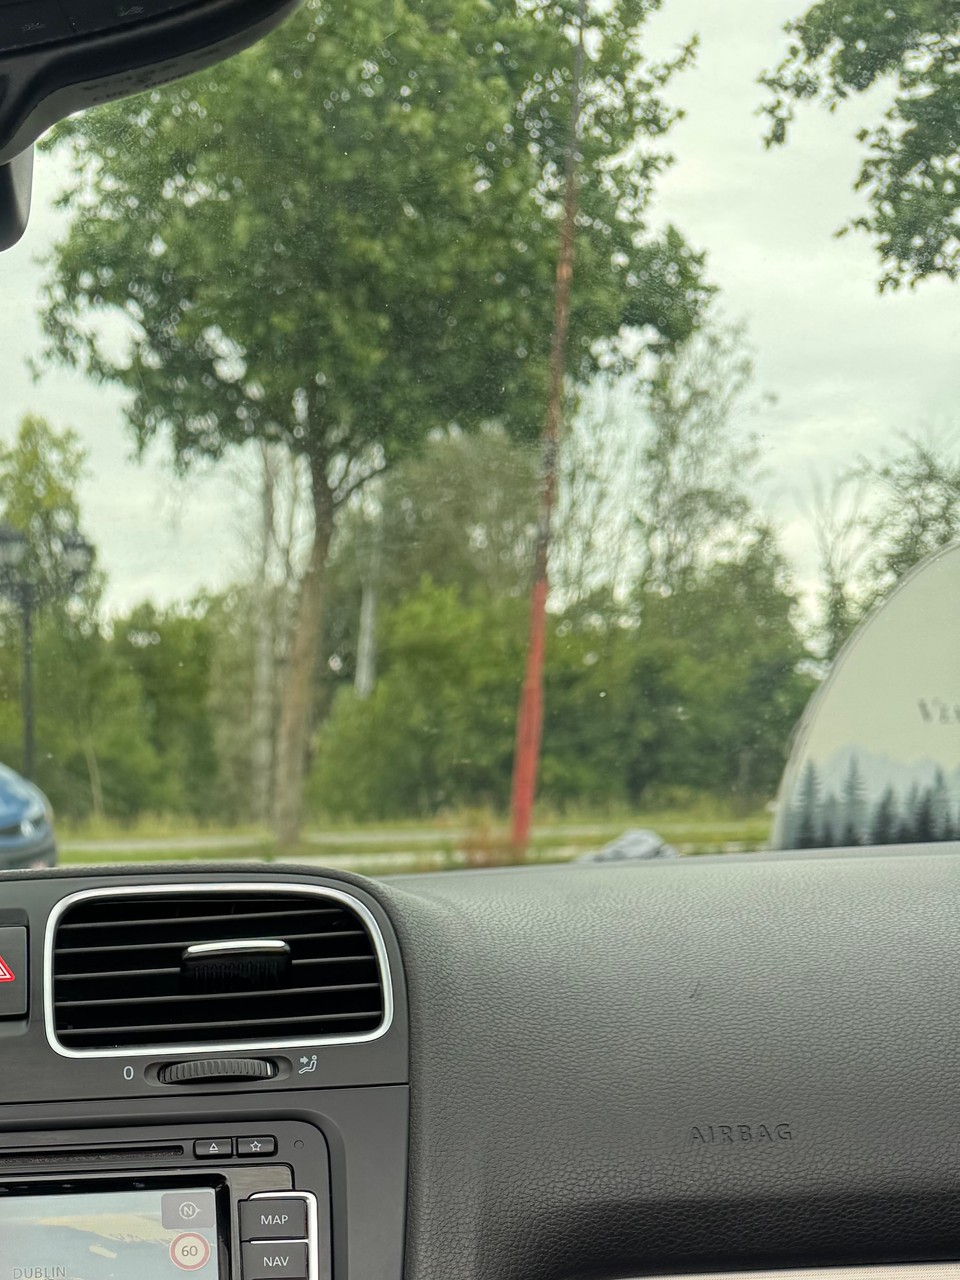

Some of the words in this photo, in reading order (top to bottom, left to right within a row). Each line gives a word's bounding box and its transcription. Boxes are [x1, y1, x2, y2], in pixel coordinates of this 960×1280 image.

[688, 1123, 793, 1145] AIRBAG
[260, 1215, 289, 1225] MAP
[181, 1245, 198, 1257] 60
[263, 1256, 290, 1267] NAV
[13, 1266, 66, 1280] DUBLIN
